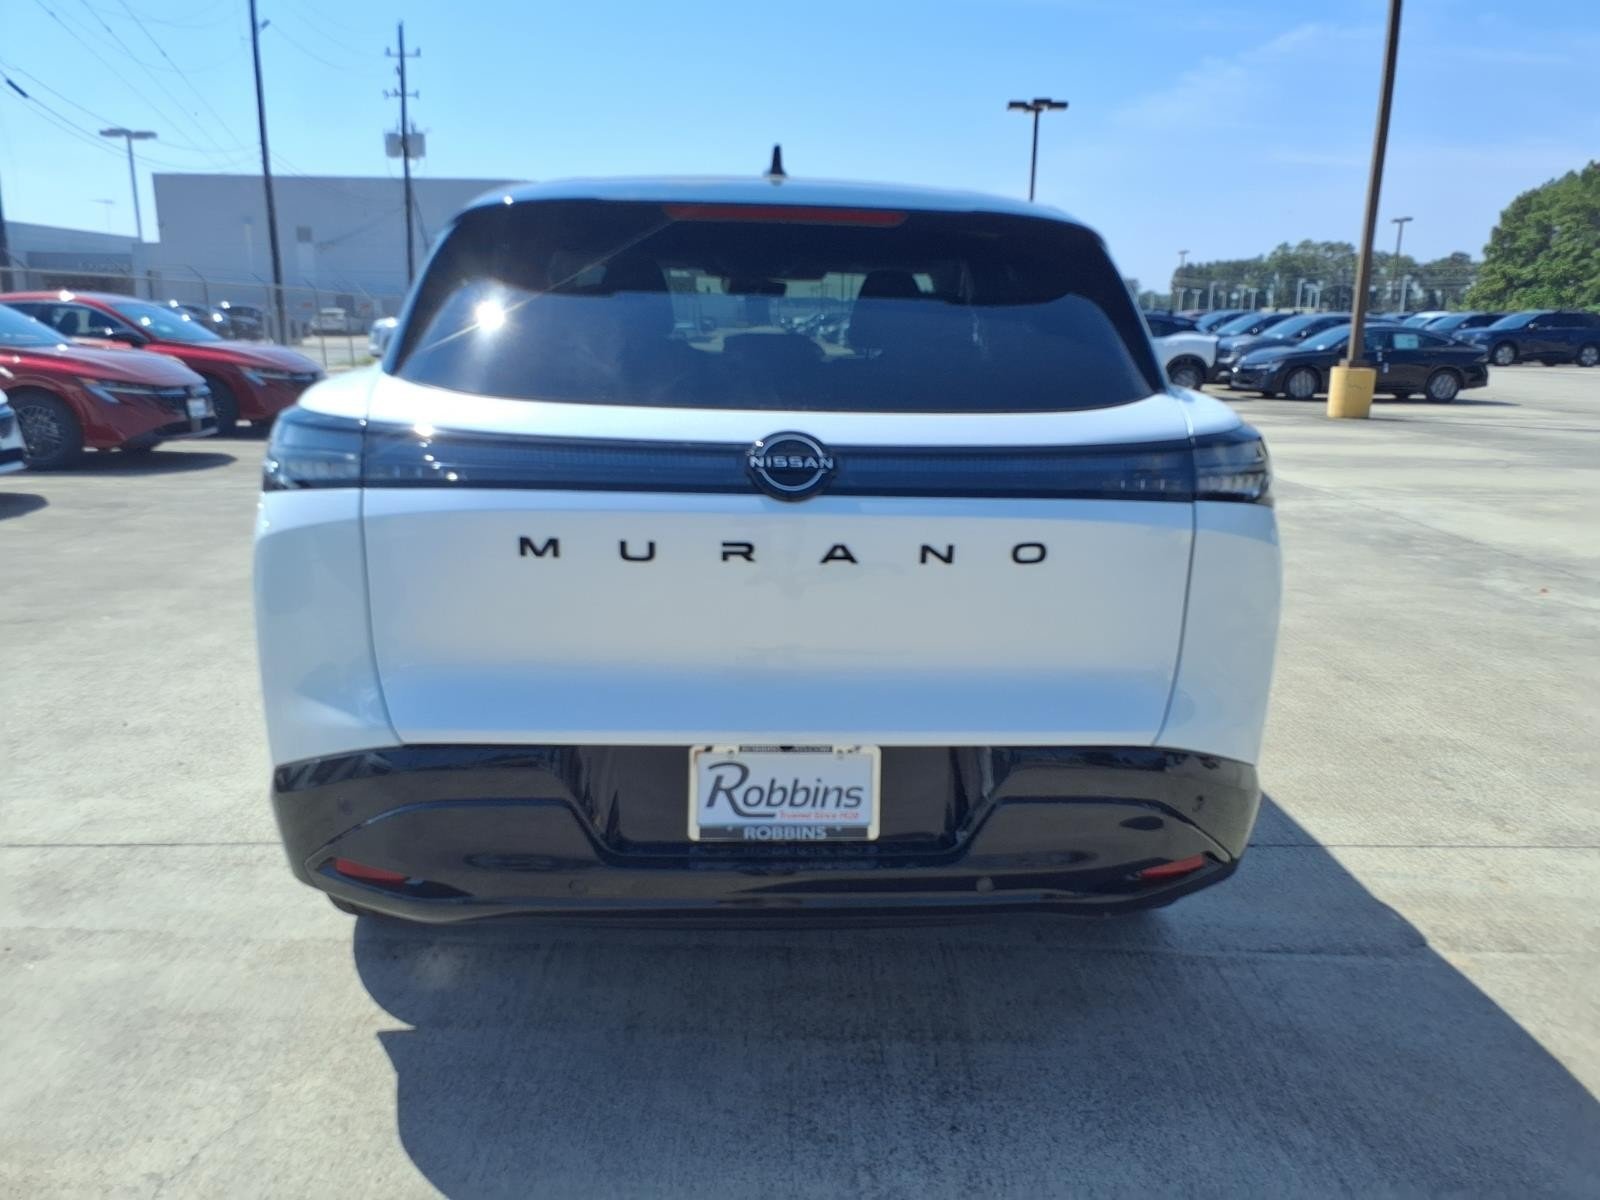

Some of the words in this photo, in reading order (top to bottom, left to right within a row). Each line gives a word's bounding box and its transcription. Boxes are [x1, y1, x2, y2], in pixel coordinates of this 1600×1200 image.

[750, 455, 834, 470] NISSAN
[518, 536, 1048, 565] MURANO
[706, 761, 864, 818] Robbins
[743, 825, 827, 841] ROBBINS
